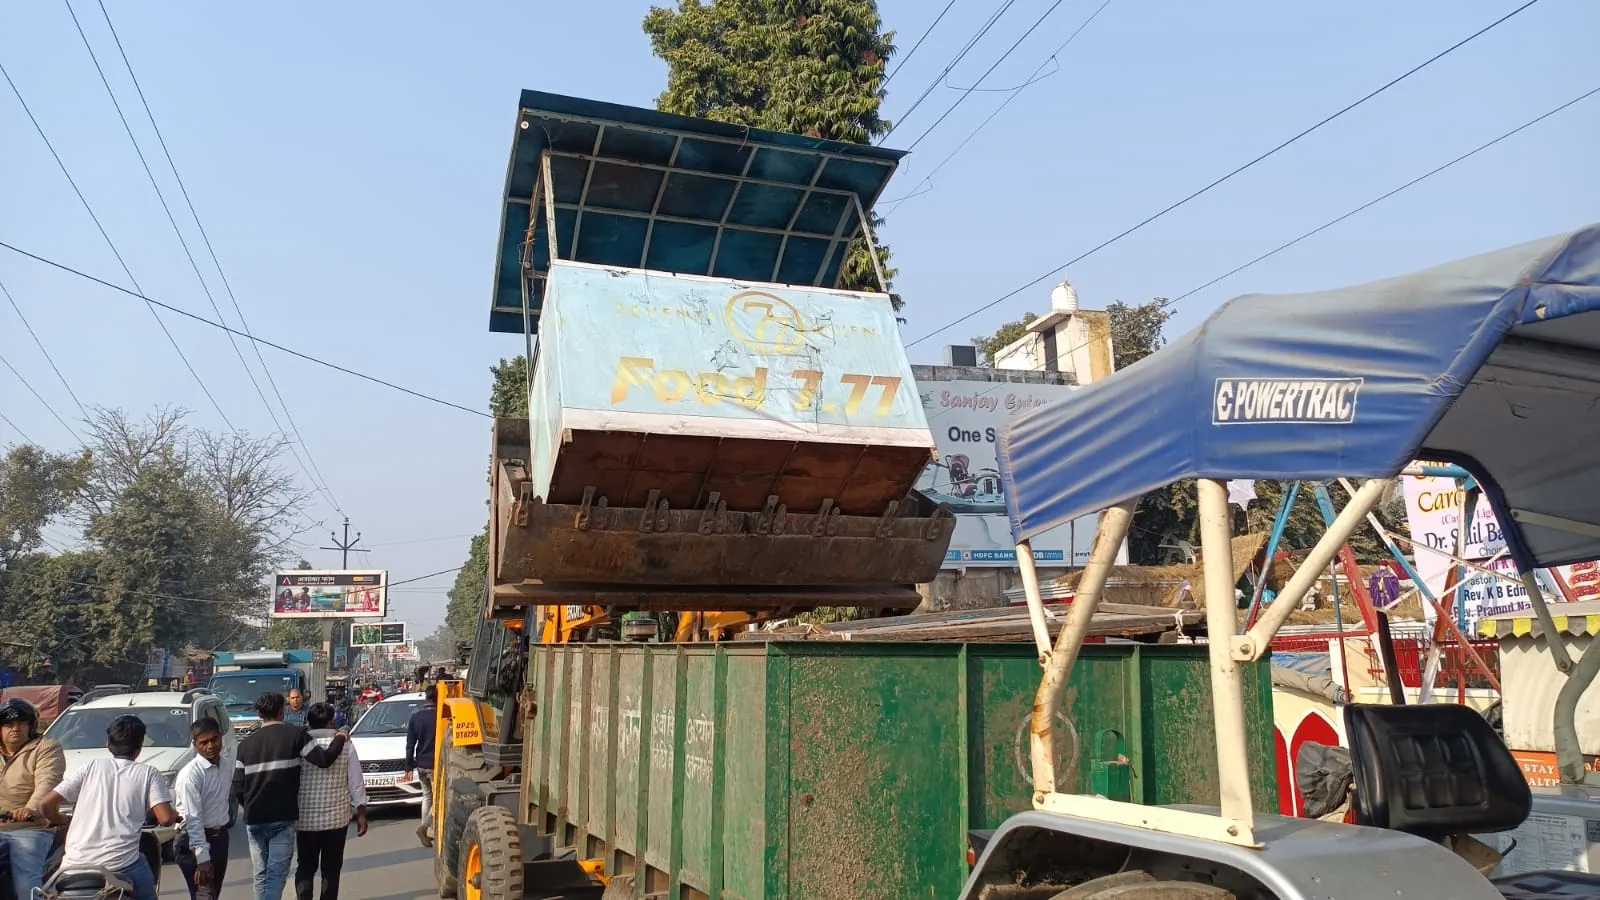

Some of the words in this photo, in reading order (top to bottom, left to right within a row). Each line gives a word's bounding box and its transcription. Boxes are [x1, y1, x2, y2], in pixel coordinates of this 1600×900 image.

[611, 356, 768, 409] Food
[940, 391, 998, 412] Sanjay
[948, 426, 981, 442] One
[1424, 532, 1448, 549] Dr.
[1464, 588, 1485, 602] Rev.
[1487, 586, 1495, 598] K
[1497, 585, 1504, 597] B
[1523, 763, 1555, 774] STAY
